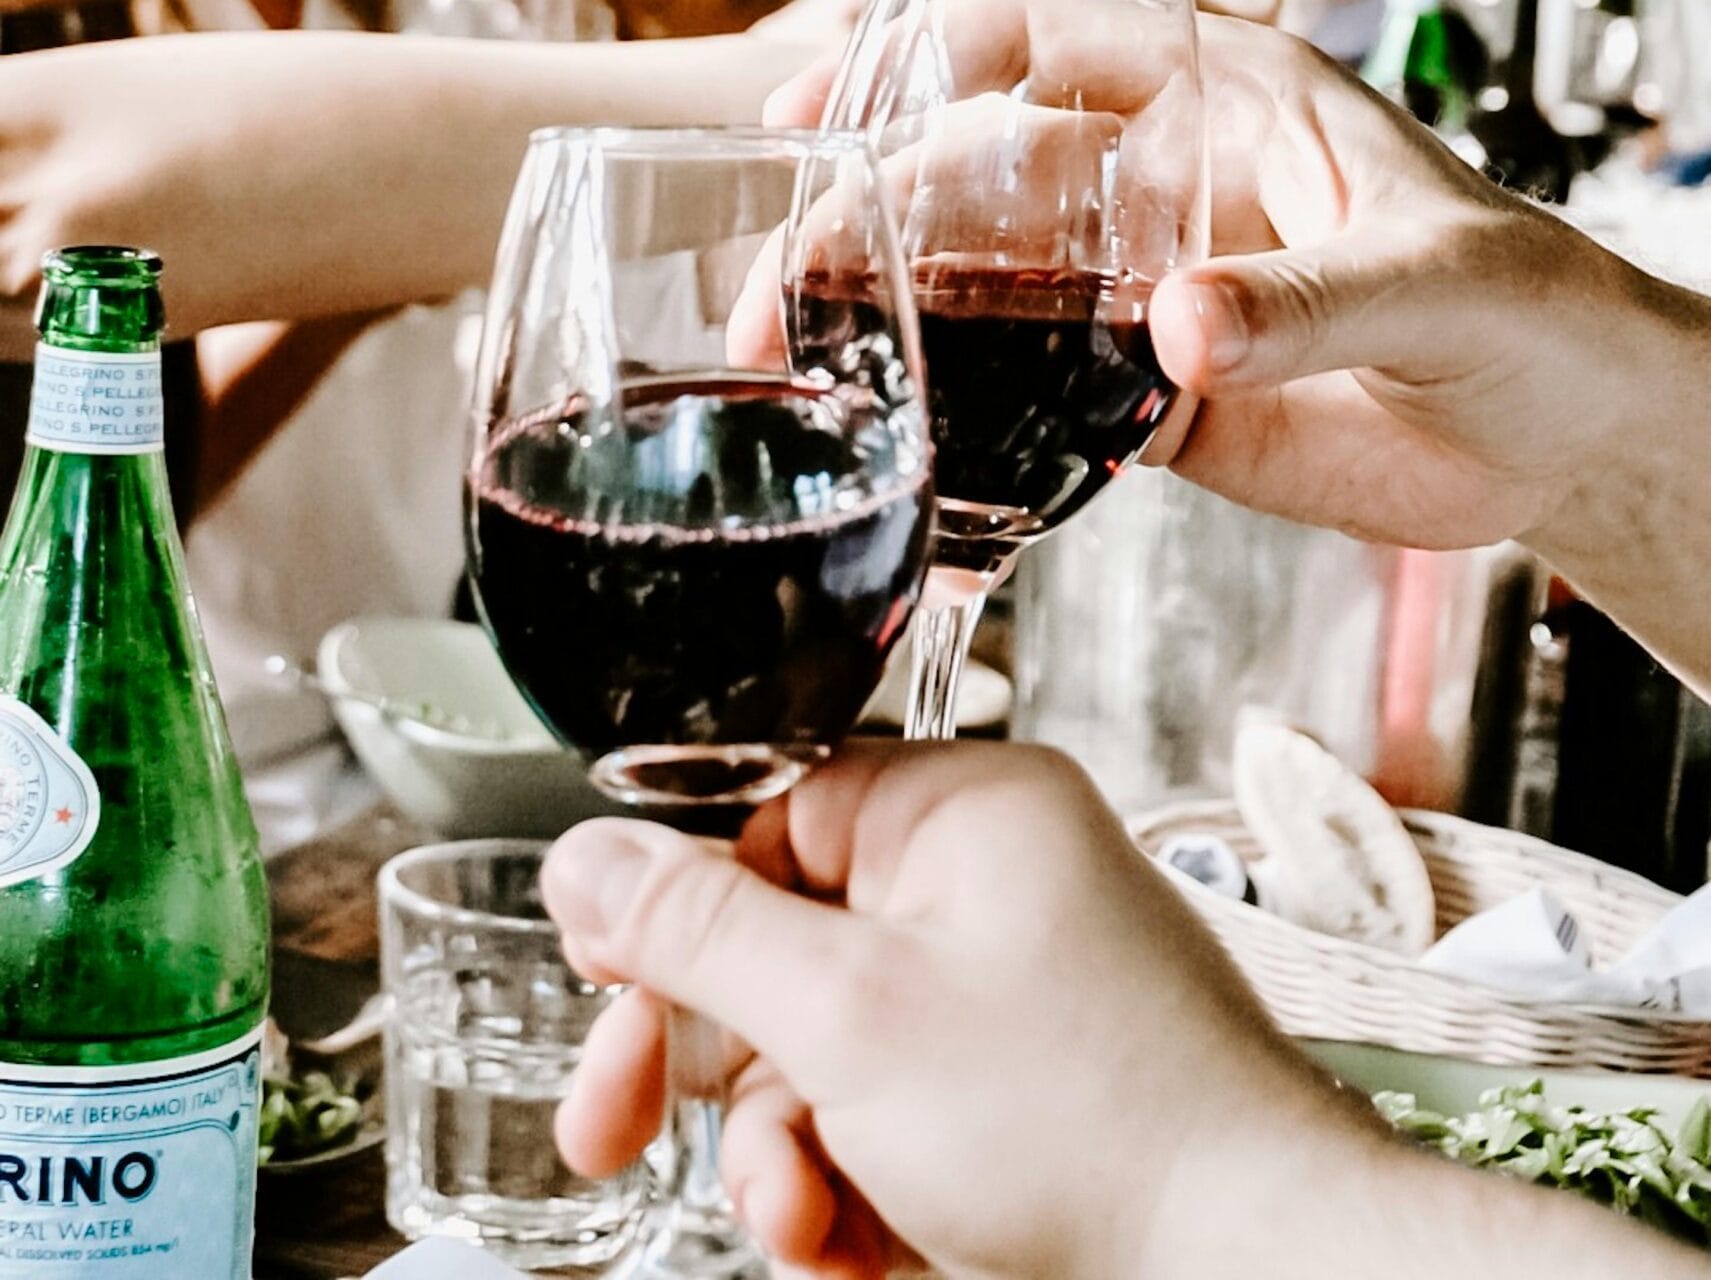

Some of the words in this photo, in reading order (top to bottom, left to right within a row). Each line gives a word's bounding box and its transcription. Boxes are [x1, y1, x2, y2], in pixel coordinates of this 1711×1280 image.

[7, 775, 40, 846] TERME
[15, 1105, 74, 1125] TERME
[82, 1096, 186, 1127] (BERGAMO)
[192, 1084, 224, 1111] ITALY
[57, 1218, 134, 1241] WATER
